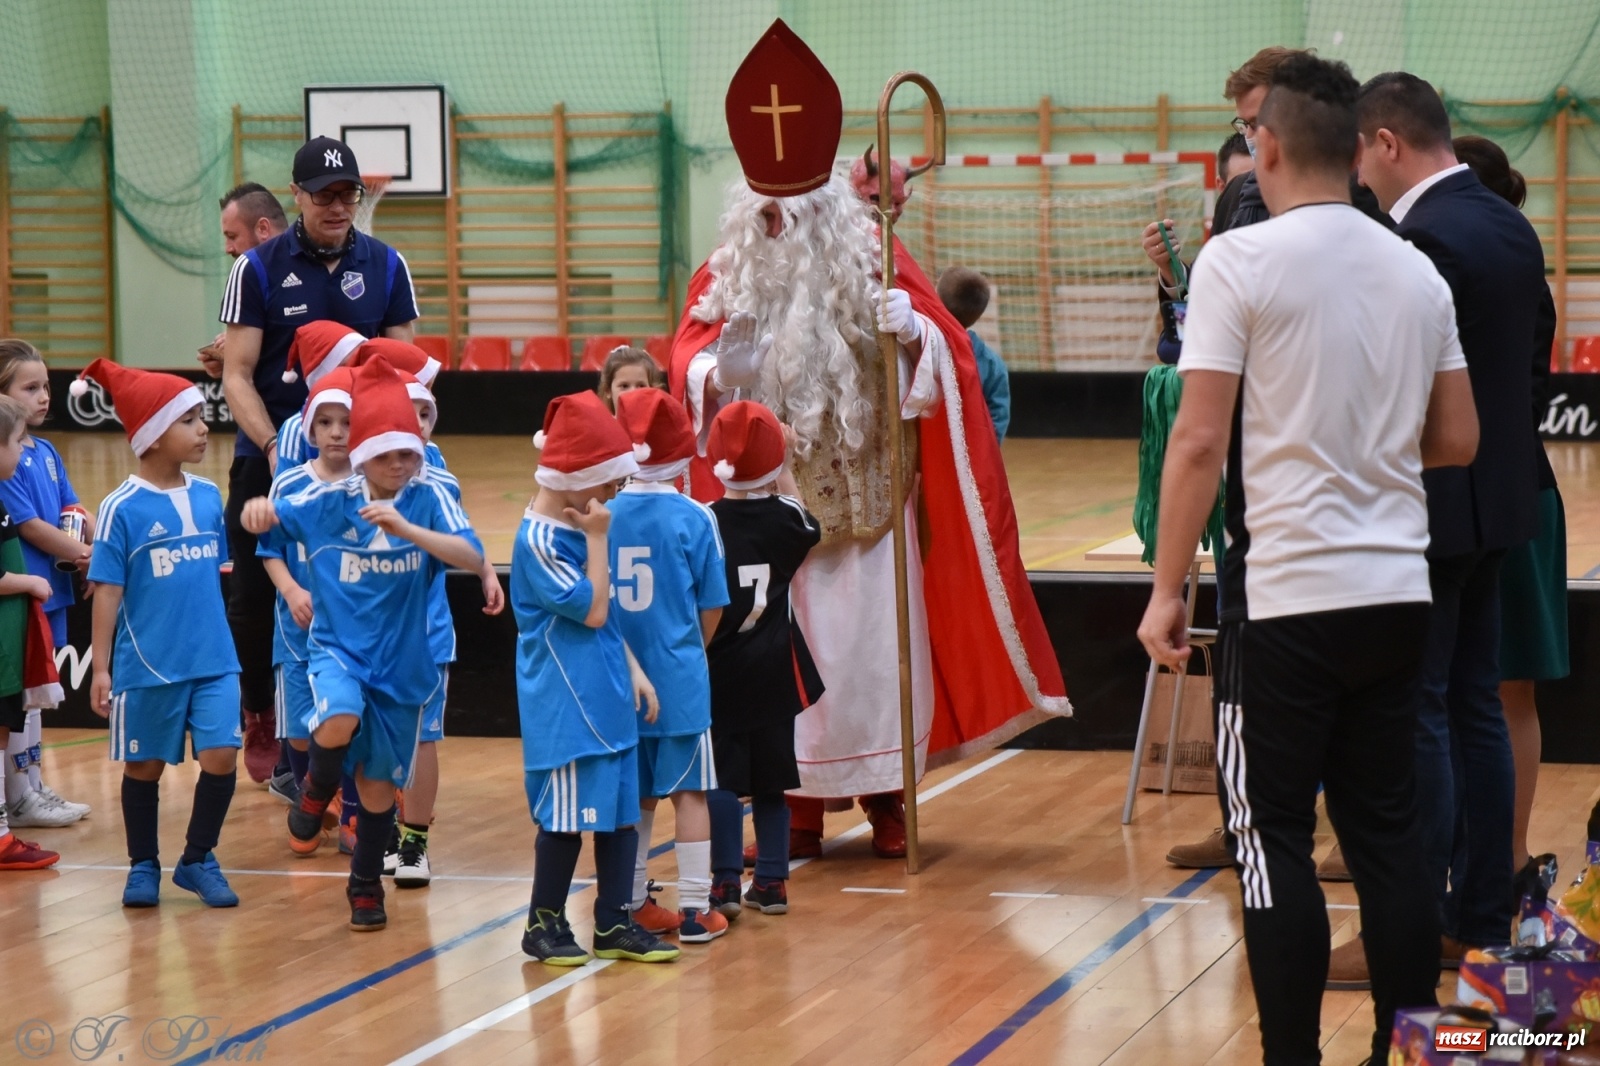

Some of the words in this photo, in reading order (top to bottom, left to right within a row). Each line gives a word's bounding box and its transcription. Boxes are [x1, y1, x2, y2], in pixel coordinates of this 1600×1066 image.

[323, 149, 343, 168] NY
[617, 546, 654, 612] 5
[737, 563, 770, 633] 7
[129, 739, 139, 754] 6
[581, 807, 597, 824] 18
